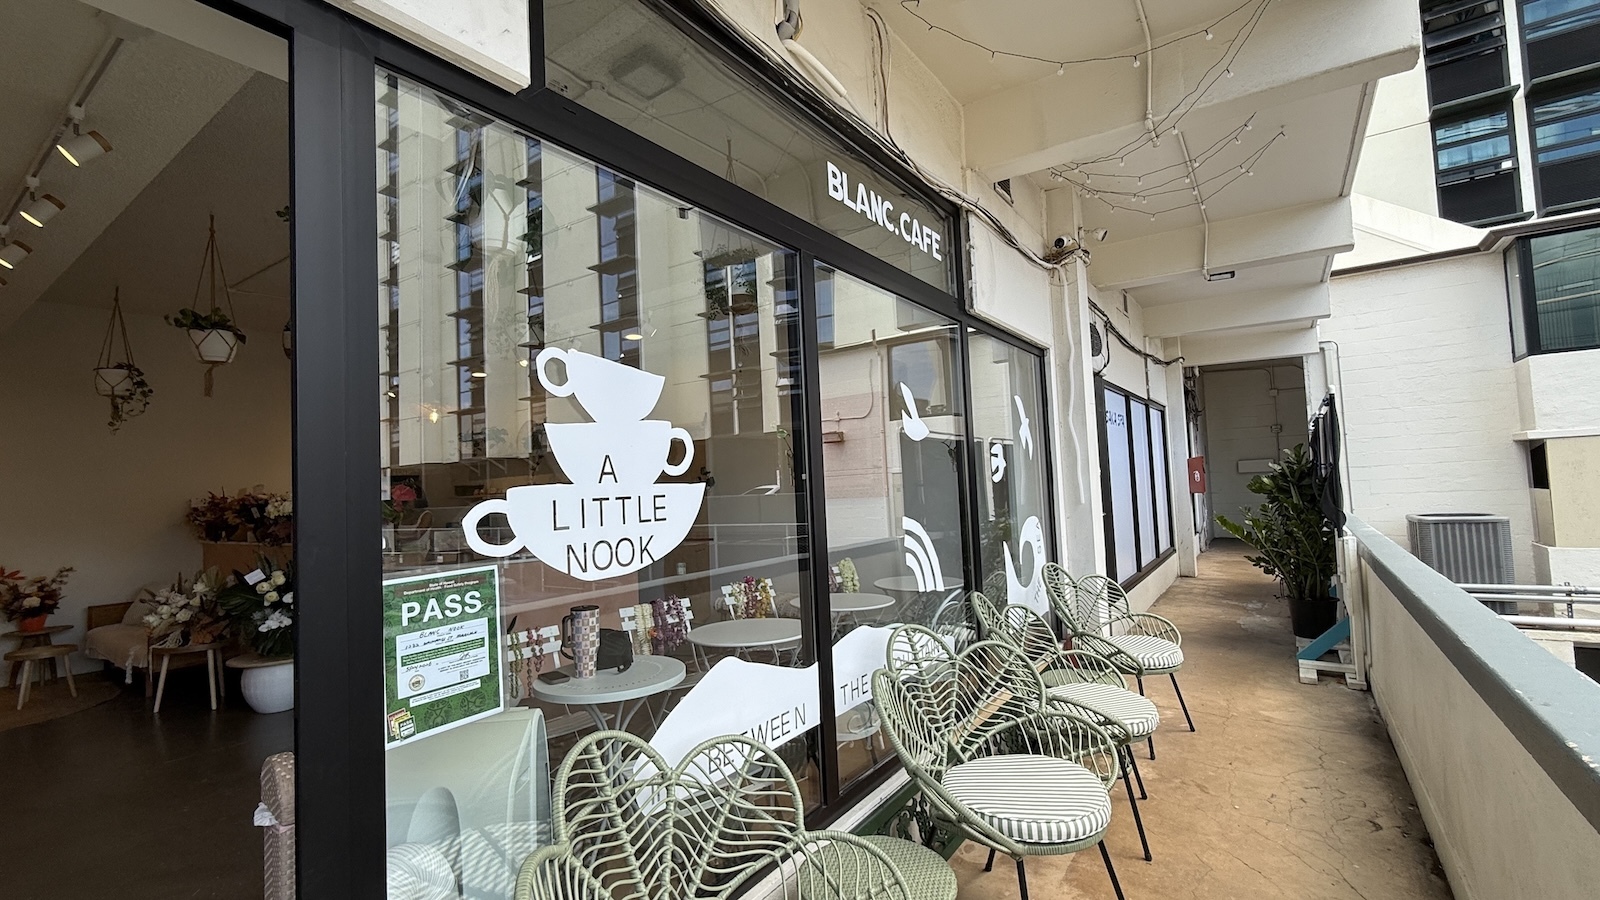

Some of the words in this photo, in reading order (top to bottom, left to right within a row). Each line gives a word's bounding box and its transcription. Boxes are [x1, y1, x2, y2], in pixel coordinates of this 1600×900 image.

[827, 161, 942, 262] BLANC.CAFE
[598, 454, 618, 484] A
[552, 494, 667, 531] LITTLE
[566, 534, 656, 576] NOOK
[401, 590, 482, 627] PASS
[840, 673, 869, 705] THE
